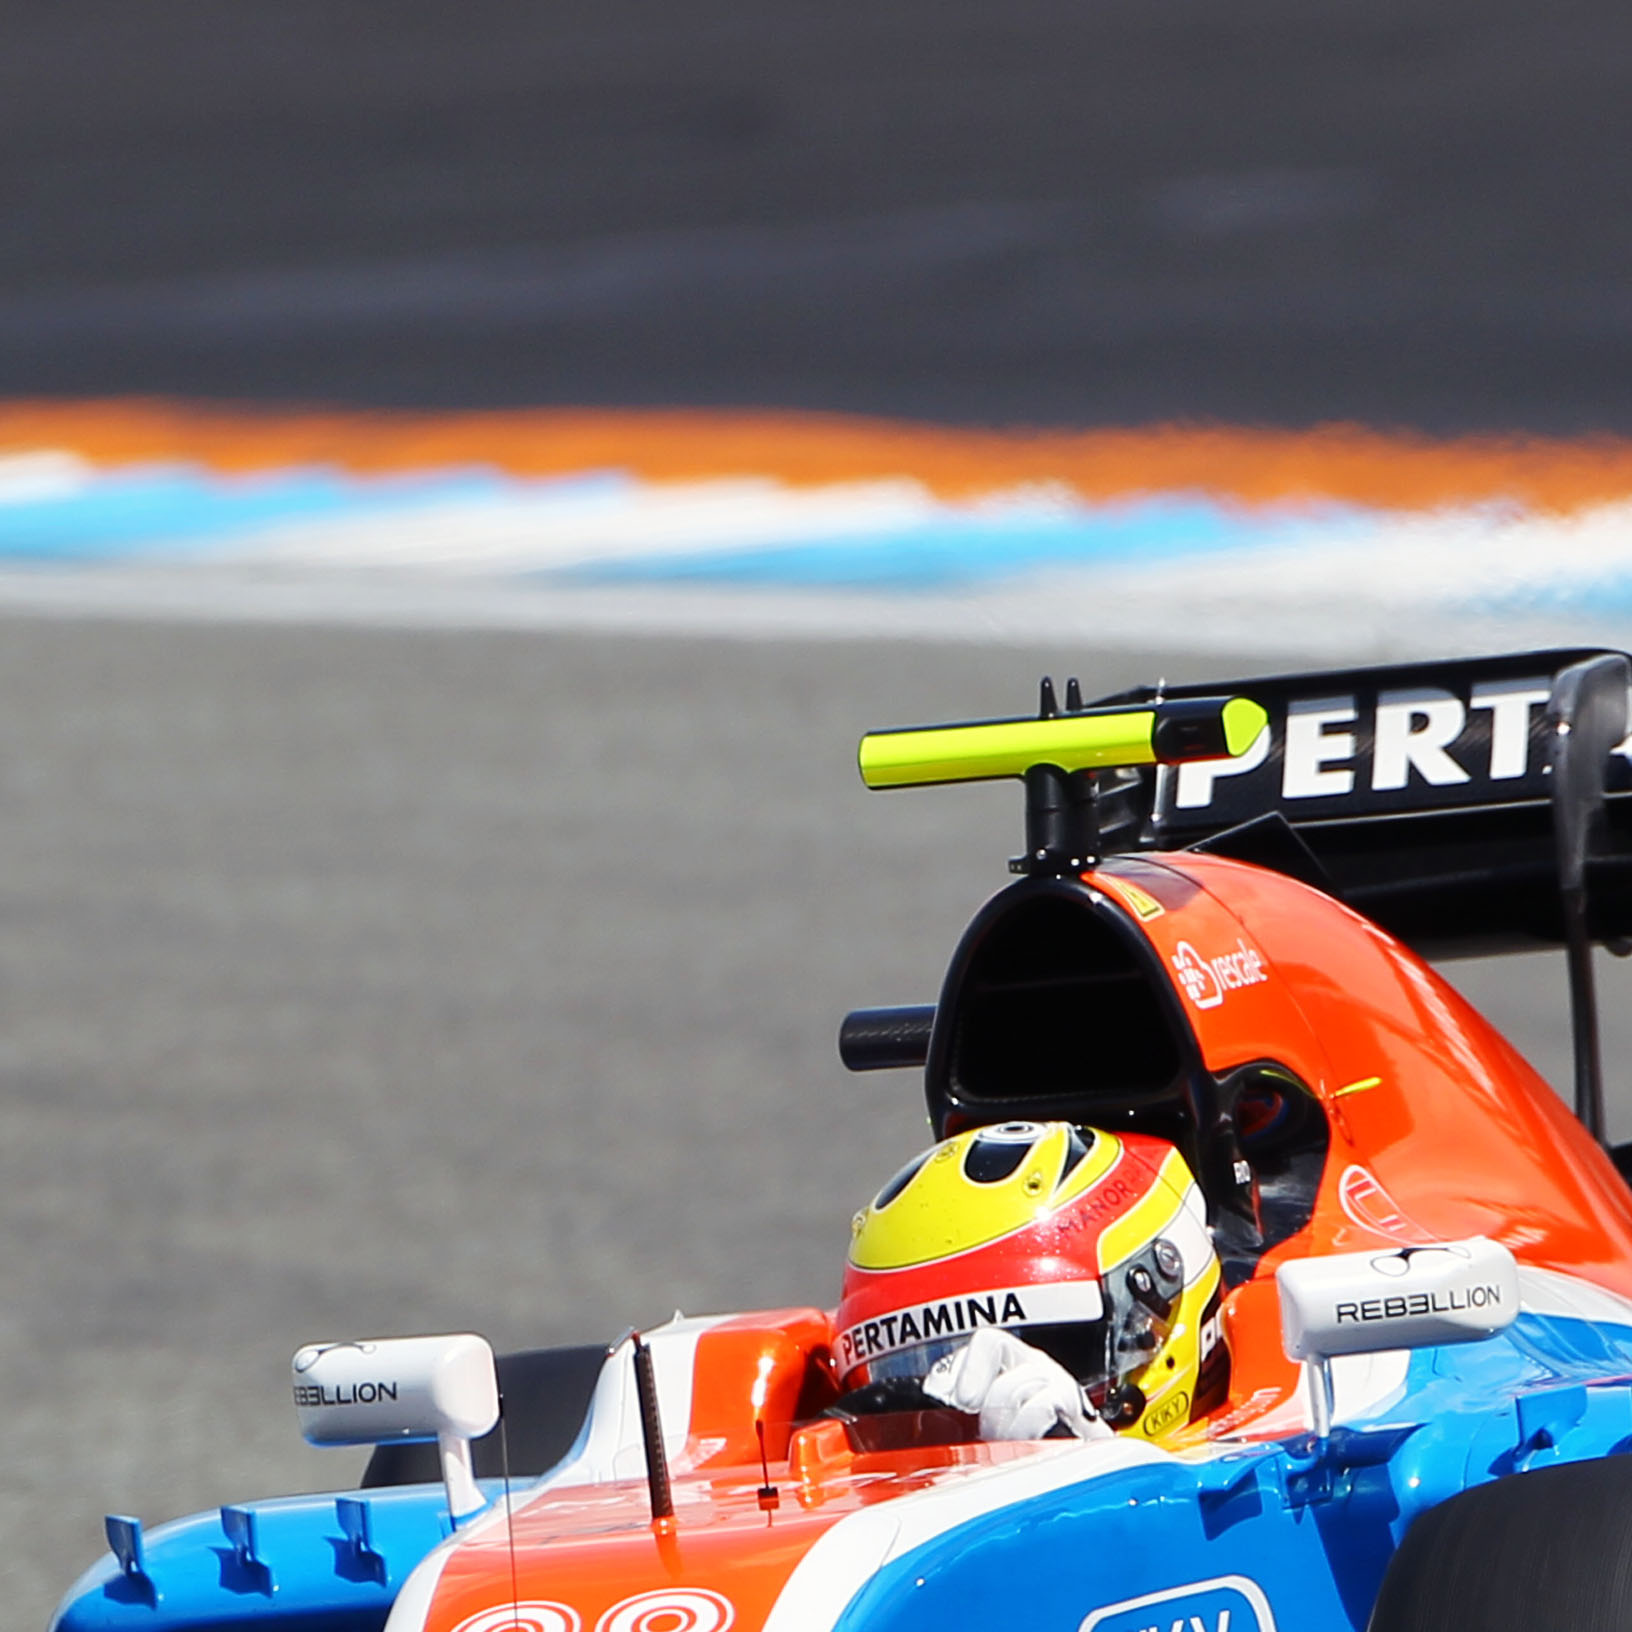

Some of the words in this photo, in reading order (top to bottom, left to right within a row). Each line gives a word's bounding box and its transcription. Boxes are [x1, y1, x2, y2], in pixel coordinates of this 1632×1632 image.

[1210, 937, 1268, 992] rescale
[1057, 1179, 1131, 1234] MANOR
[842, 1291, 1027, 1366] PERTAMINA
[1151, 1398, 1181, 1431] KIKY
